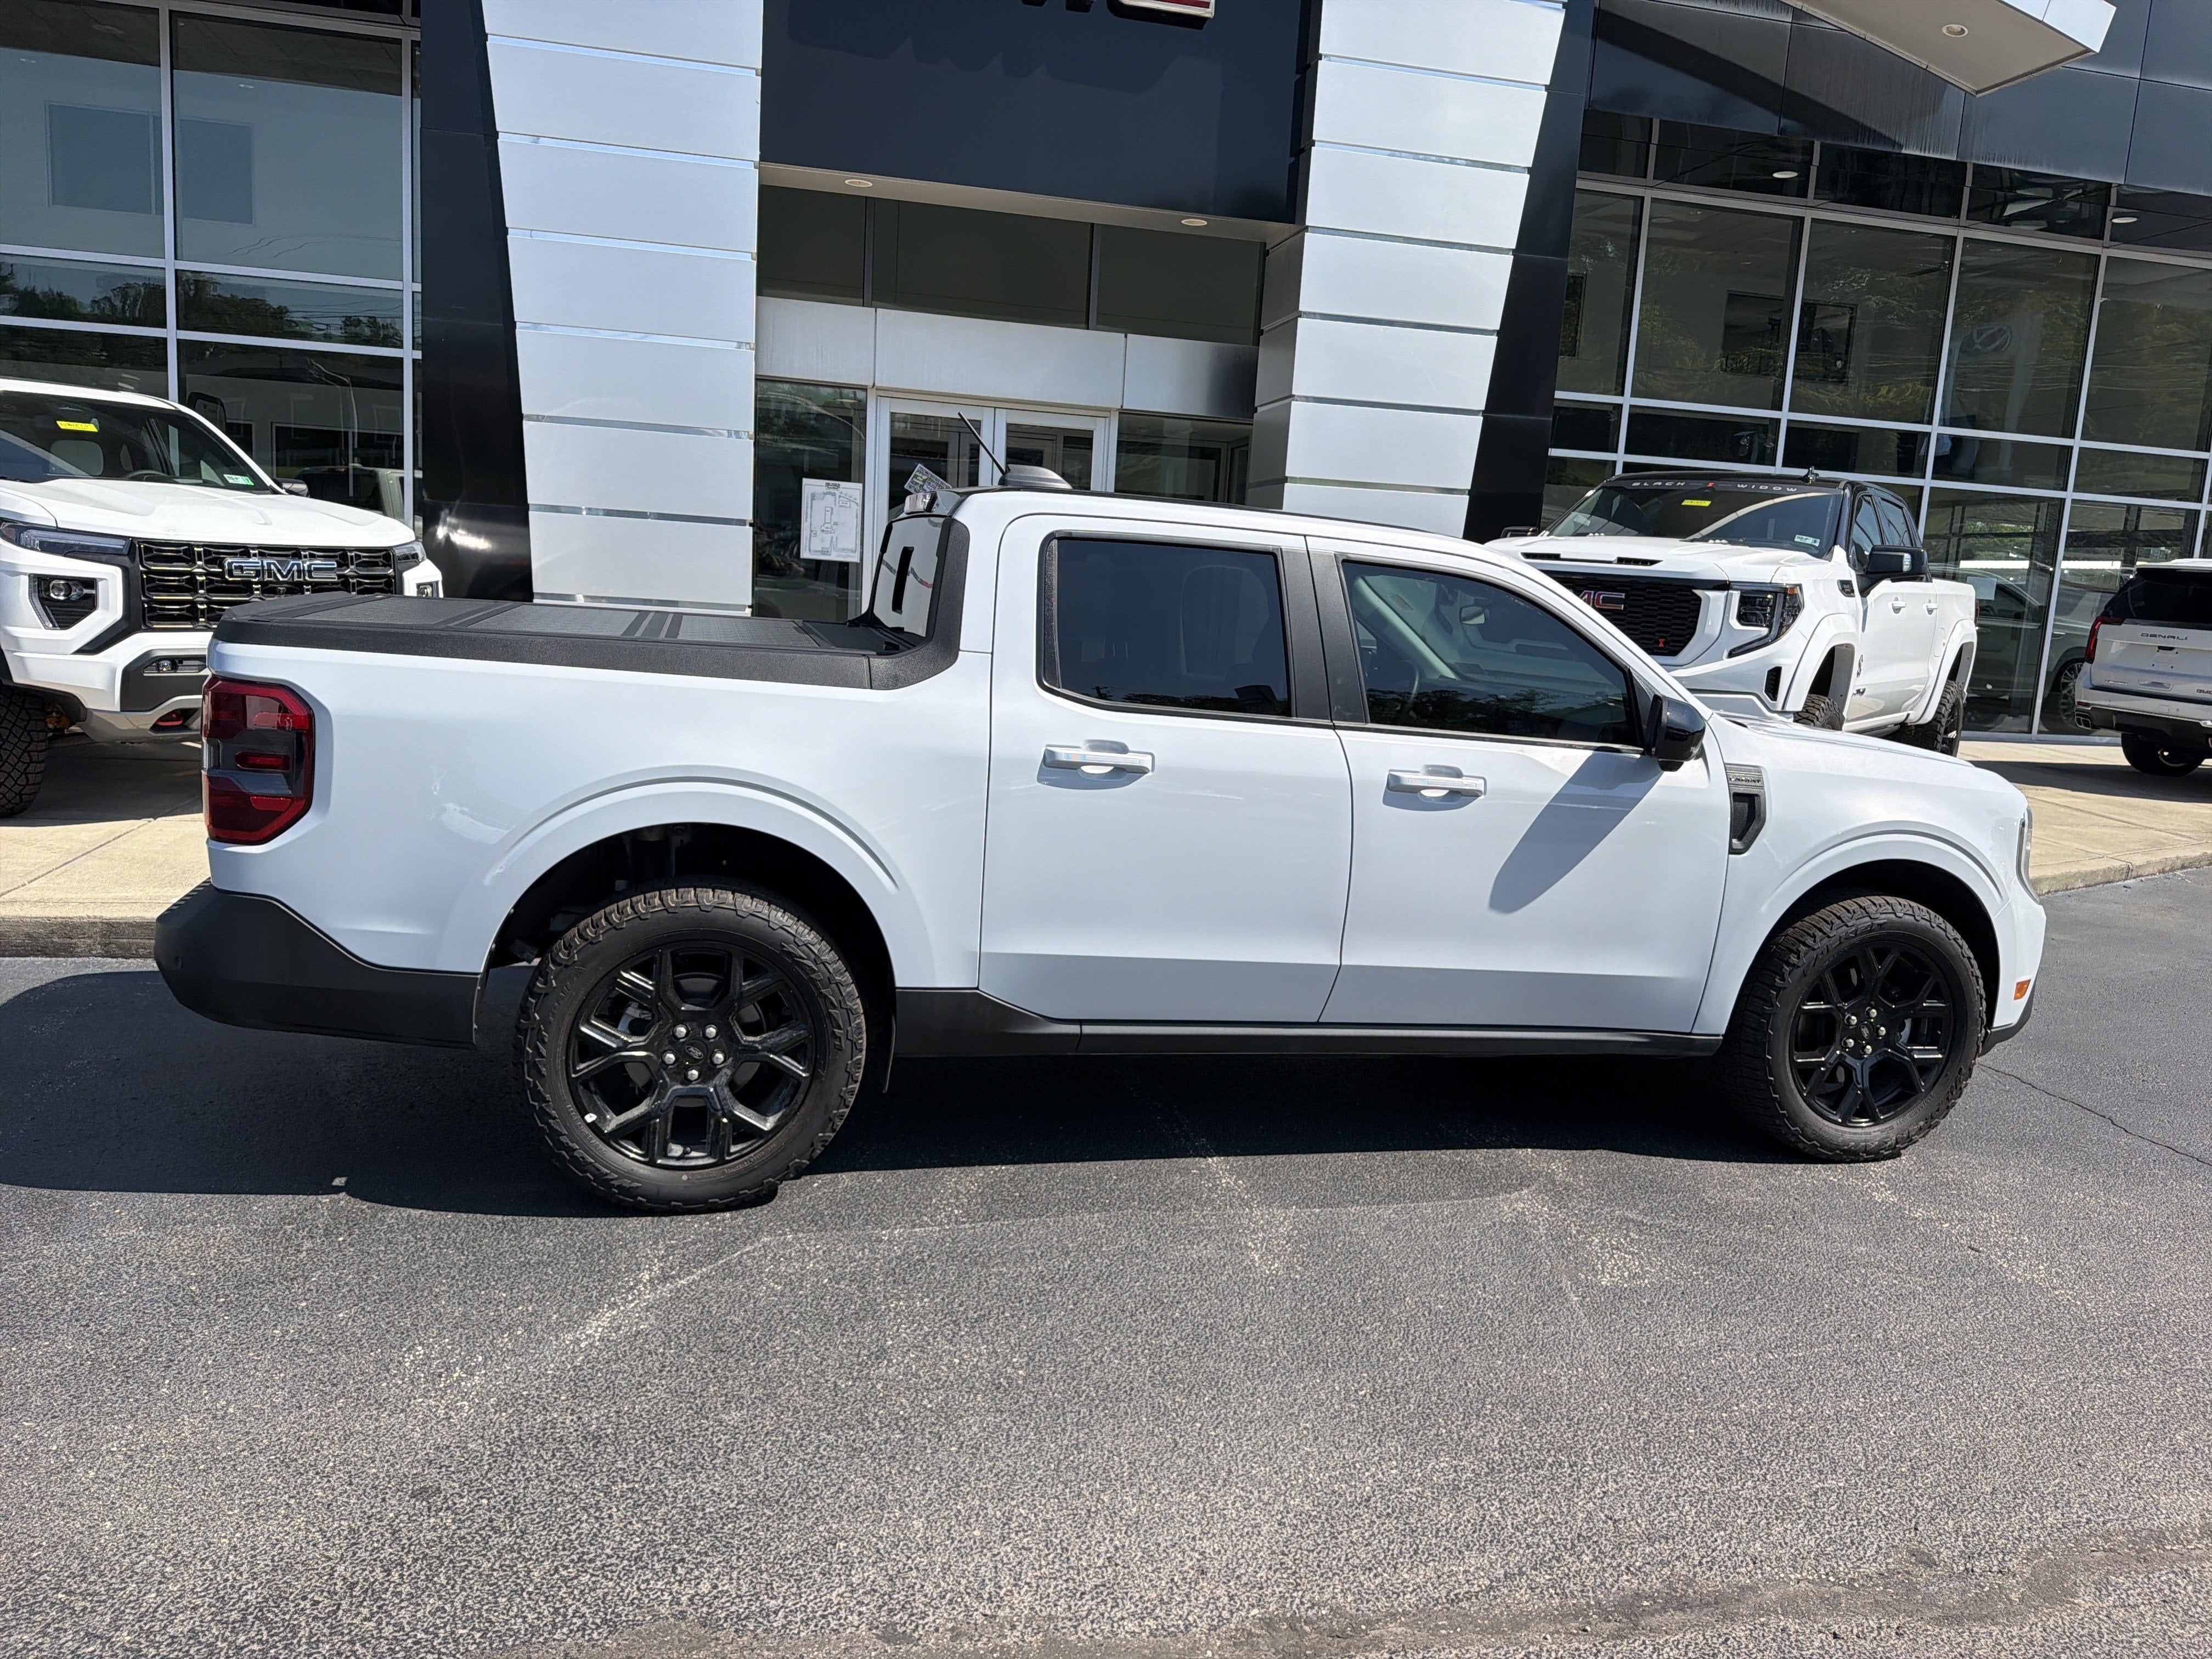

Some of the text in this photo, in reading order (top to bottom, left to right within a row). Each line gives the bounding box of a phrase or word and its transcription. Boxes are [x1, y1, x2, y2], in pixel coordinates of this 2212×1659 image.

[1737, 483, 1797, 492] WIDOW
[224, 557, 338, 582] GMC
[1579, 590, 1626, 611] MC
[2141, 633, 2188, 641] DENALI
